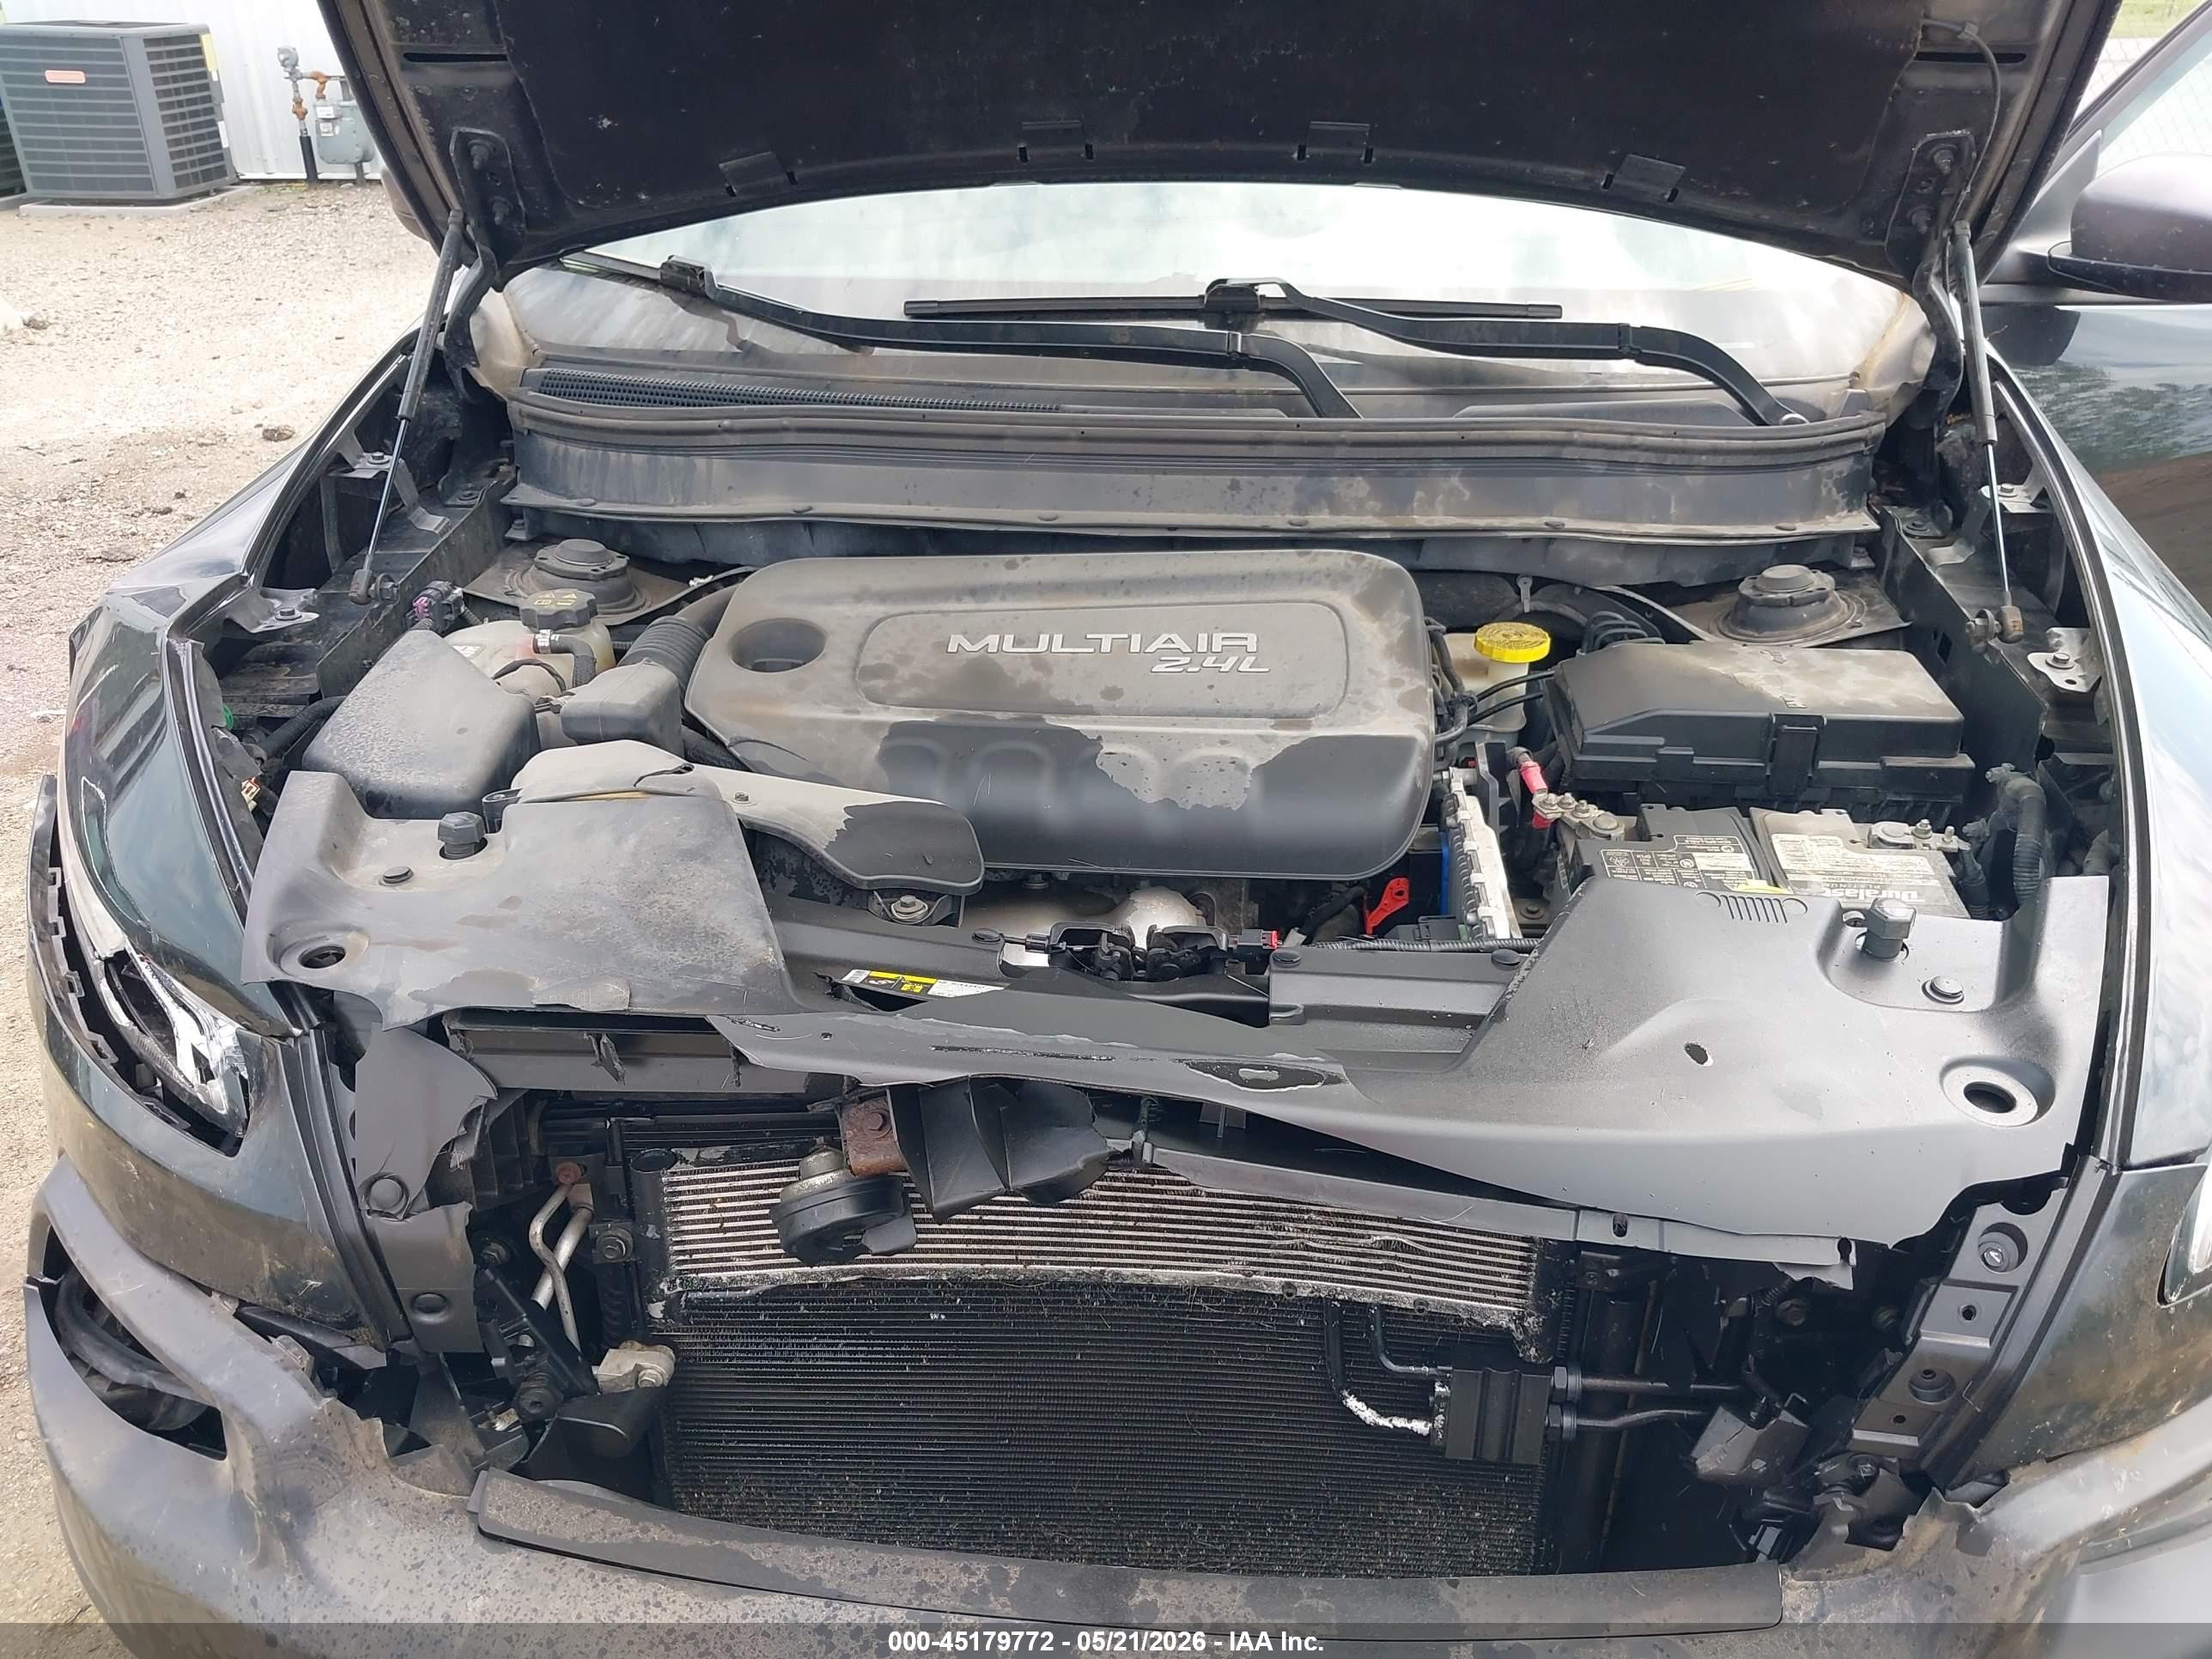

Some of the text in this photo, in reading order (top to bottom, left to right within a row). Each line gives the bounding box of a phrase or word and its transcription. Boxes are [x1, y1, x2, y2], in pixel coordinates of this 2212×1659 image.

[946, 633, 1257, 654] MULTIAIR
[1150, 655, 1271, 673] 2.4L
[1822, 888, 1924, 902] Duralast
